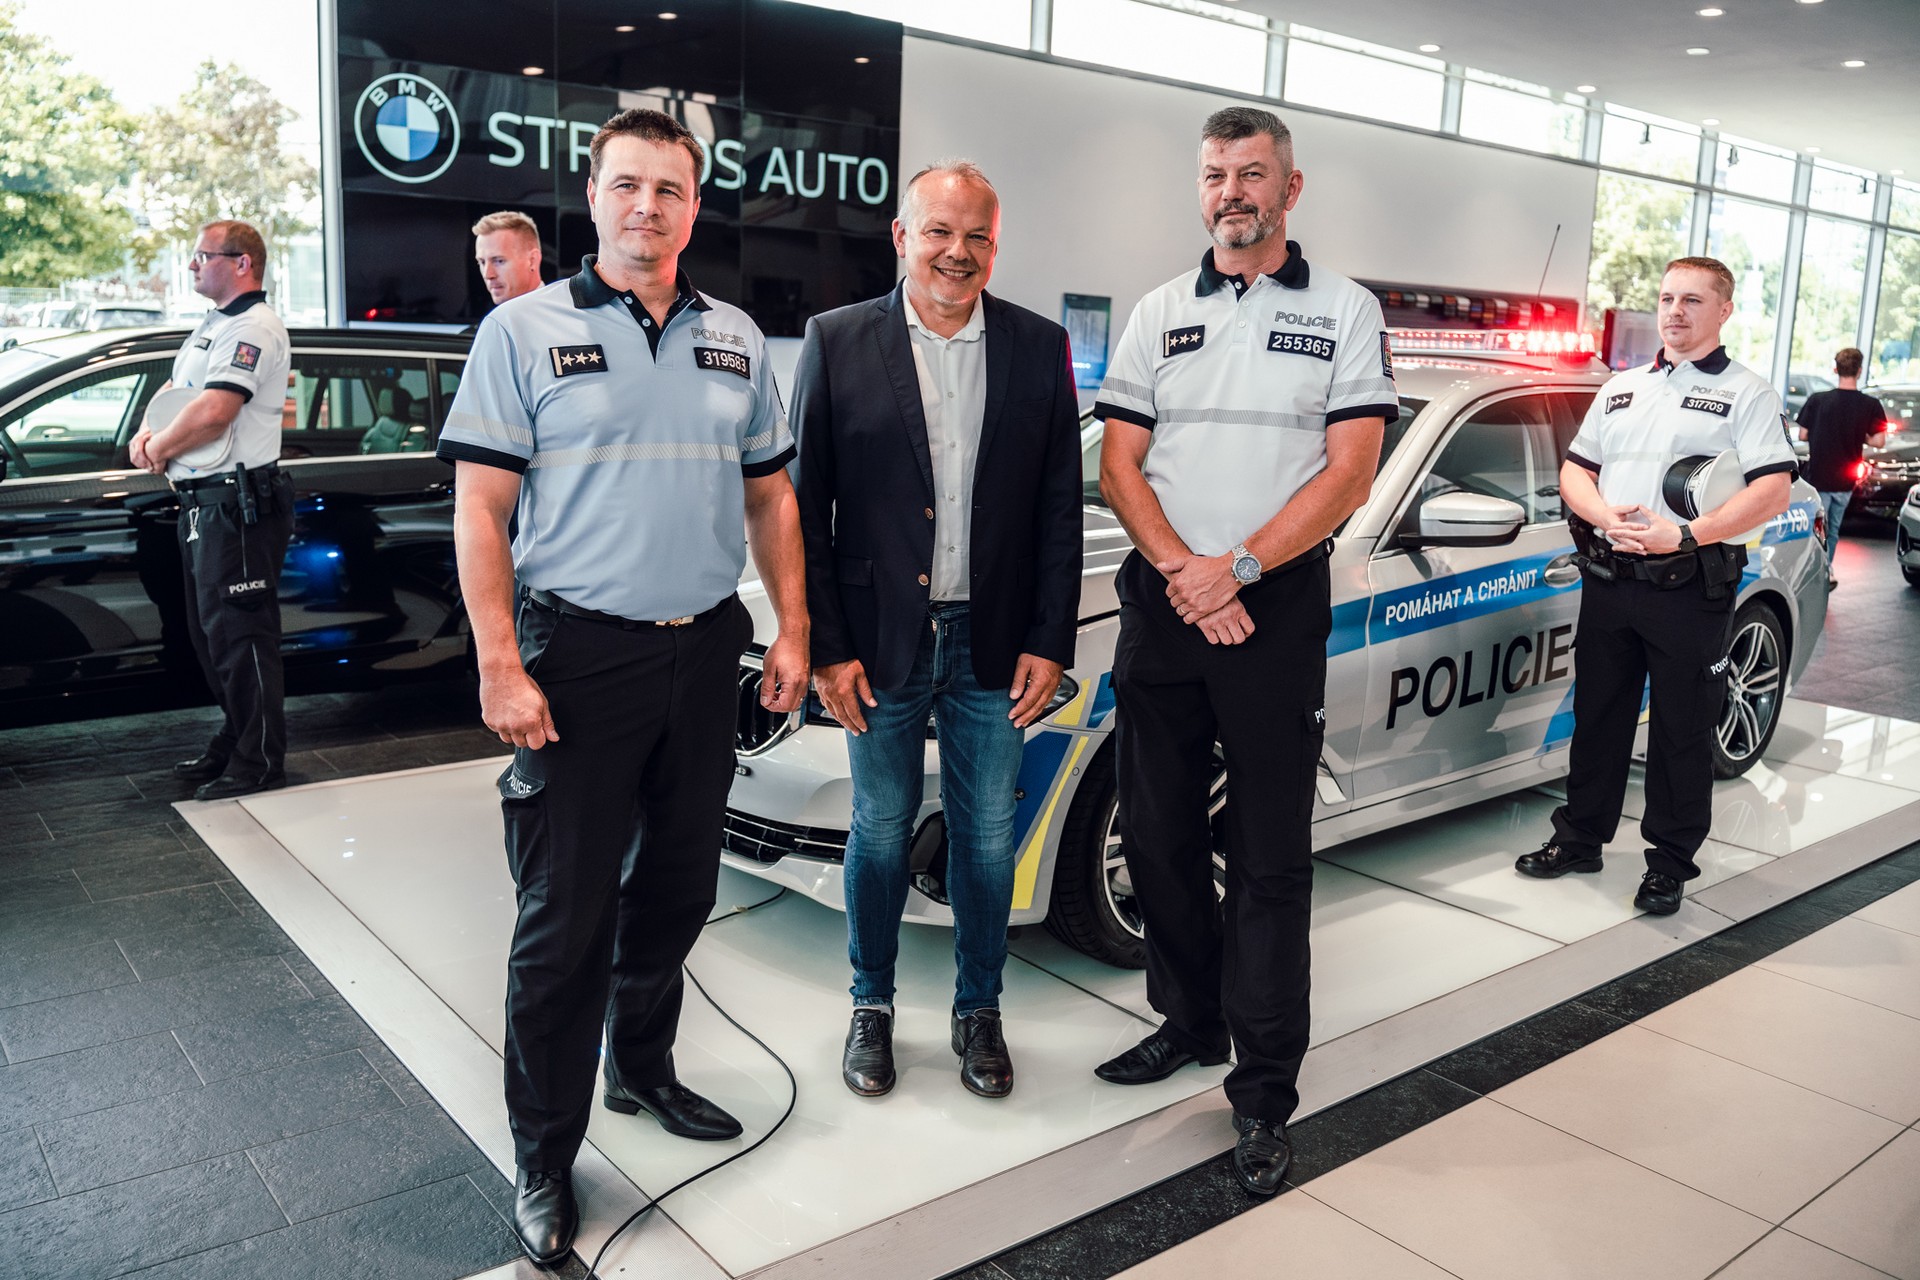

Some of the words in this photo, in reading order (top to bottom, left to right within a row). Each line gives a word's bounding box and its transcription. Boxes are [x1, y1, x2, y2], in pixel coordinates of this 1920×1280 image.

[369, 79, 446, 114] BMW
[759, 146, 889, 205] AUTO
[1274, 311, 1336, 330] POLICIE
[691, 327, 746, 348] POLICIE
[1272, 335, 1331, 357] 255365
[703, 351, 747, 373] 319583
[1690, 385, 1737, 400] POLICIE
[1687, 399, 1724, 413] 317709
[229, 579, 266, 595] POLICIE
[1385, 588, 1461, 626] POMÁHAT
[1463, 589, 1474, 605] A
[1478, 569, 1537, 602] CHRÁNIT
[1386, 623, 1572, 731] POLICIE
